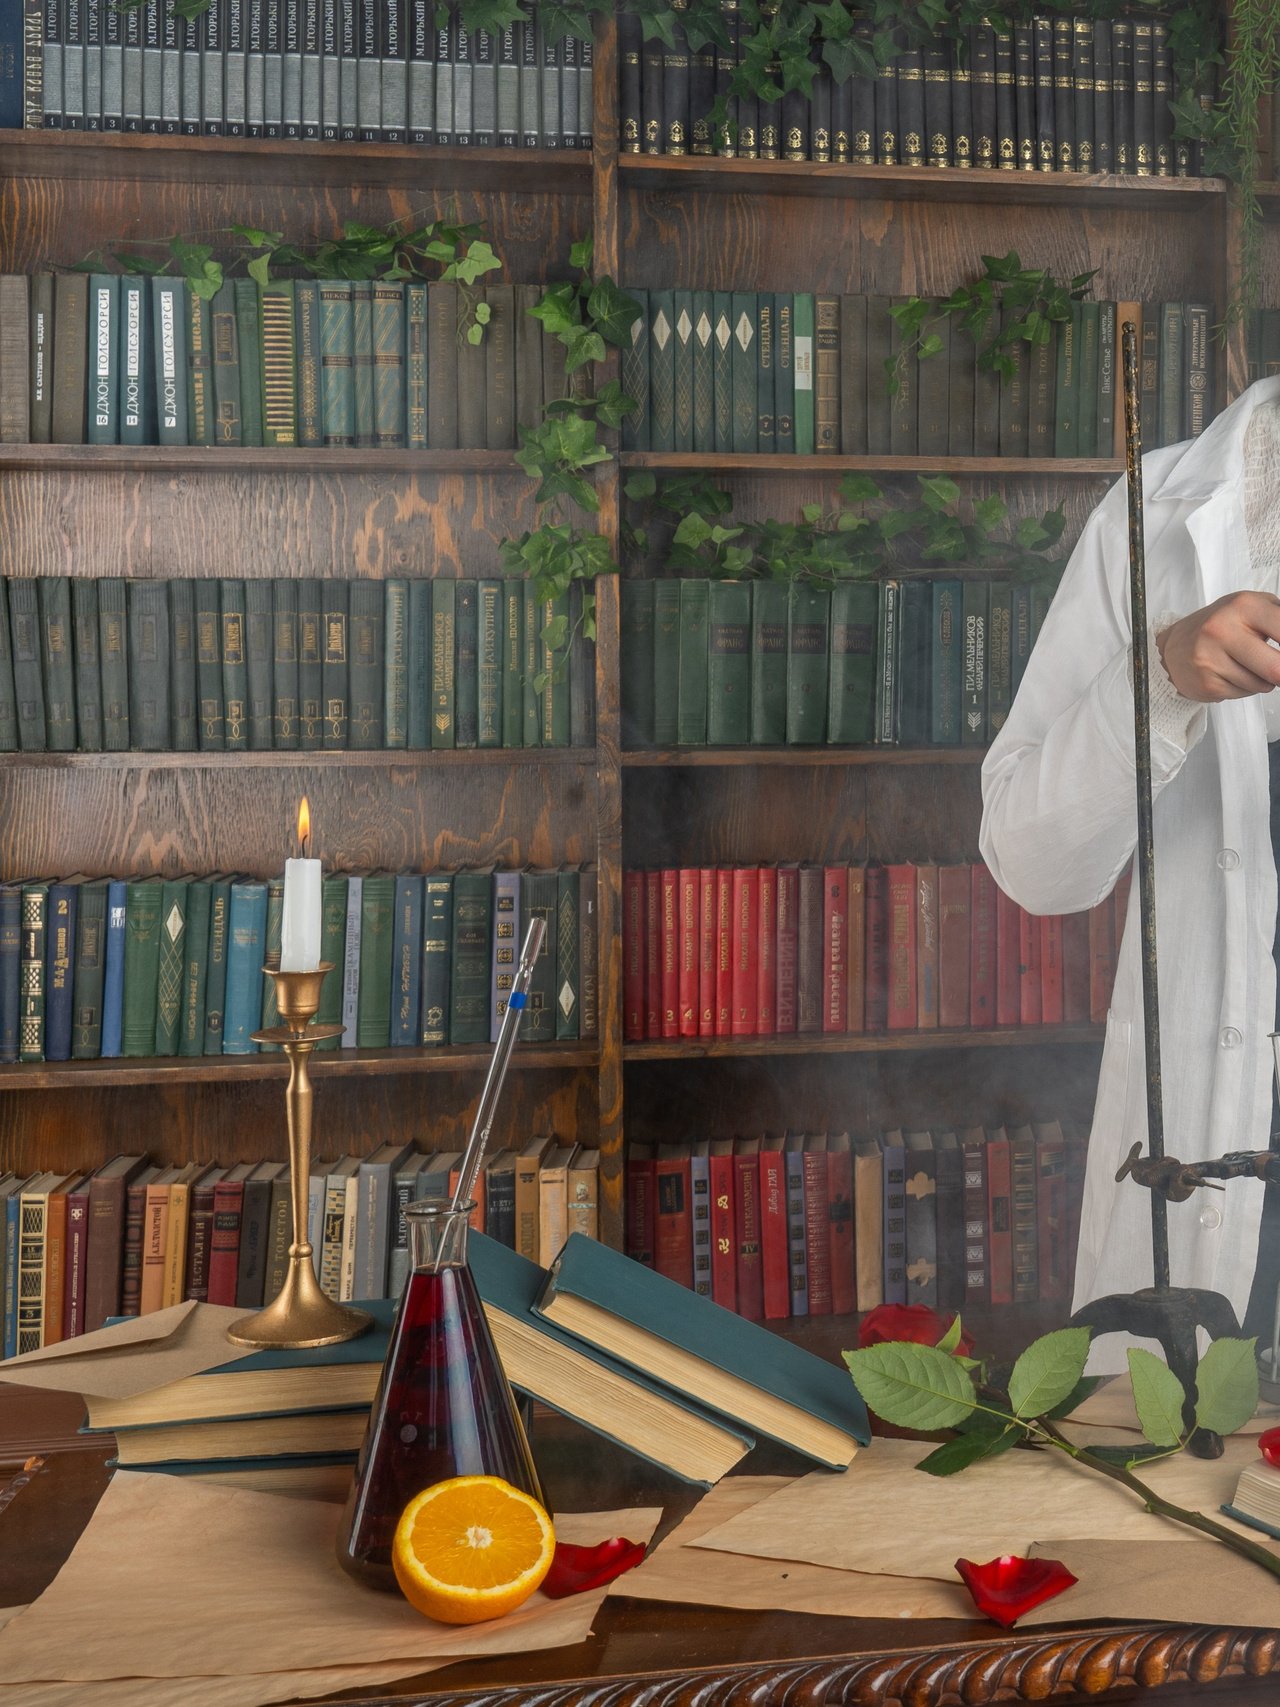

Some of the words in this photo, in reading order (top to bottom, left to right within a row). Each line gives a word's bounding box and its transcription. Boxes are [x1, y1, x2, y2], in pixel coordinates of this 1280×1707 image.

[364, 0, 374, 55] М.ГОРЬКИЙ
[387, 0, 397, 56] М.ГОРЬКИЙ
[415, 0, 425, 57] М.ГОРЬКИЙ
[49, 118, 55, 126] 1
[71, 119, 77, 127] 1
[91, 121, 97, 129] 2
[109, 120, 116, 128] 3
[129, 122, 136, 130] 4
[149, 123, 156, 131] 4
[168, 124, 174, 132] 5
[188, 125, 194, 133] 5
[210, 125, 217, 134] 6
[232, 126, 239, 135] 6
[252, 127, 258, 136] 7
[269, 127, 276, 136] 8
[289, 127, 296, 136] 8
[307, 128, 314, 136] 9
[324, 129, 333, 138] 10
[344, 130, 353, 139] 10
[365, 132, 373, 140] 11
[388, 133, 397, 141] 12
[415, 133, 424, 142] 12
[438, 135, 448, 144] 13
[459, 135, 468, 144] 13
[479, 136, 488, 145] 14
[504, 136, 512, 145] 14
[526, 137, 536, 146] 15
[565, 137, 575, 147] 16
[582, 137, 592, 147] 16
[99, 291, 109, 371] ГОЛСУОРСИ
[128, 292, 139, 371] ГОЛСУОРСИ
[163, 293, 175, 373] ГОЛСУОРСИ
[760, 306, 771, 369] СТЕНДАЛЬ
[779, 306, 790, 369] СТЕНДАЛЬ
[1102, 348, 1111, 374] Селье
[1102, 373, 1110, 394] Ганс
[98, 376, 110, 415] ДЖОН
[128, 376, 139, 414] ДЖОН
[165, 378, 177, 416] ДЖОН
[98, 415, 107, 425] 16
[168, 417, 174, 426] 7
[763, 421, 769, 429] 7
[1010, 423, 1021, 433] 16
[1036, 423, 1047, 434] 18
[1063, 422, 1070, 431] 7
[509, 596, 517, 639] ШОЛОХОВ
[527, 599, 536, 640] ШОЛОХОВ
[394, 595, 404, 663] А.И.КУПРИН
[485, 595, 495, 663] А.И.КУПРИН
[1018, 596, 1028, 657] СТЕНДАЛЬ
[434, 612, 445, 673] МЕЛЬНИКОВ
[716, 637, 744, 649] ФРАНС
[966, 615, 976, 673] МЕЛЬНИКОВ
[991, 607, 1001, 668] МЕЛЬНИКОВ
[439, 694, 447, 705] 2
[972, 694, 978, 704] 1
[996, 690, 1002, 701] 1
[58, 899, 68, 915] 2
[587, 900, 595, 914] 1
[630, 886, 639, 933] ШОЛОХОВ
[648, 886, 657, 931] ШОЛОХОВ
[665, 885, 674, 931] ШОЛОХОВ
[685, 883, 694, 929] ШОЛОХОВ
[704, 883, 713, 929] ШОЛОХОВ
[720, 883, 729, 929] ШОЛОХОВ
[741, 883, 750, 929] ШОЛОХОВ
[762, 883, 771, 929] ШОЛОХОВ
[213, 897, 225, 963] СТЕНДАЛЬ
[831, 910, 844, 962] Агата
[630, 935, 639, 976] МИХАИЛ
[648, 935, 657, 974] МИХАИЛ
[665, 934, 674, 973] МИХАИЛ
[685, 932, 694, 971] МИХАИЛ
[704, 932, 713, 971] МИХАИЛ
[720, 932, 729, 971] МИХАИЛ
[741, 932, 750, 971] МИХАИЛ
[762, 932, 771, 970] МИХАИЛ
[190, 961, 199, 976] БЕЗ
[779, 934, 793, 1026] В.И.ЛЕНИН
[189, 978, 199, 1007] ЛИНИИ
[828, 963, 844, 1024] Кристи
[632, 1012, 638, 1024] 1
[648, 1011, 657, 1023] 2
[665, 1010, 674, 1021] 3
[683, 1008, 693, 1020] 4
[703, 1008, 713, 1020] 6
[720, 1008, 729, 1020] 5
[740, 1007, 749, 1020] 7
[762, 1007, 771, 1018] 8
[187, 1009, 197, 1040] ФРОНТА
[767, 1168, 778, 1187] ГАЙ
[743, 1171, 754, 1238] Н.М.КАРАМЗИН
[768, 1188, 779, 1214] Давид
[635, 1179, 645, 1246] Н.М.КАРАМЗИН
[152, 1206, 162, 1255] А.К.ТОЛСТОЙ
[276, 1200, 288, 1262] ТОЛСТОЙ
[192, 1221, 205, 1286] И.СТАЛИН
[745, 1245, 755, 1255] IV
[721, 1270, 730, 1282] 2
[26, 1308, 35, 1317] 3
